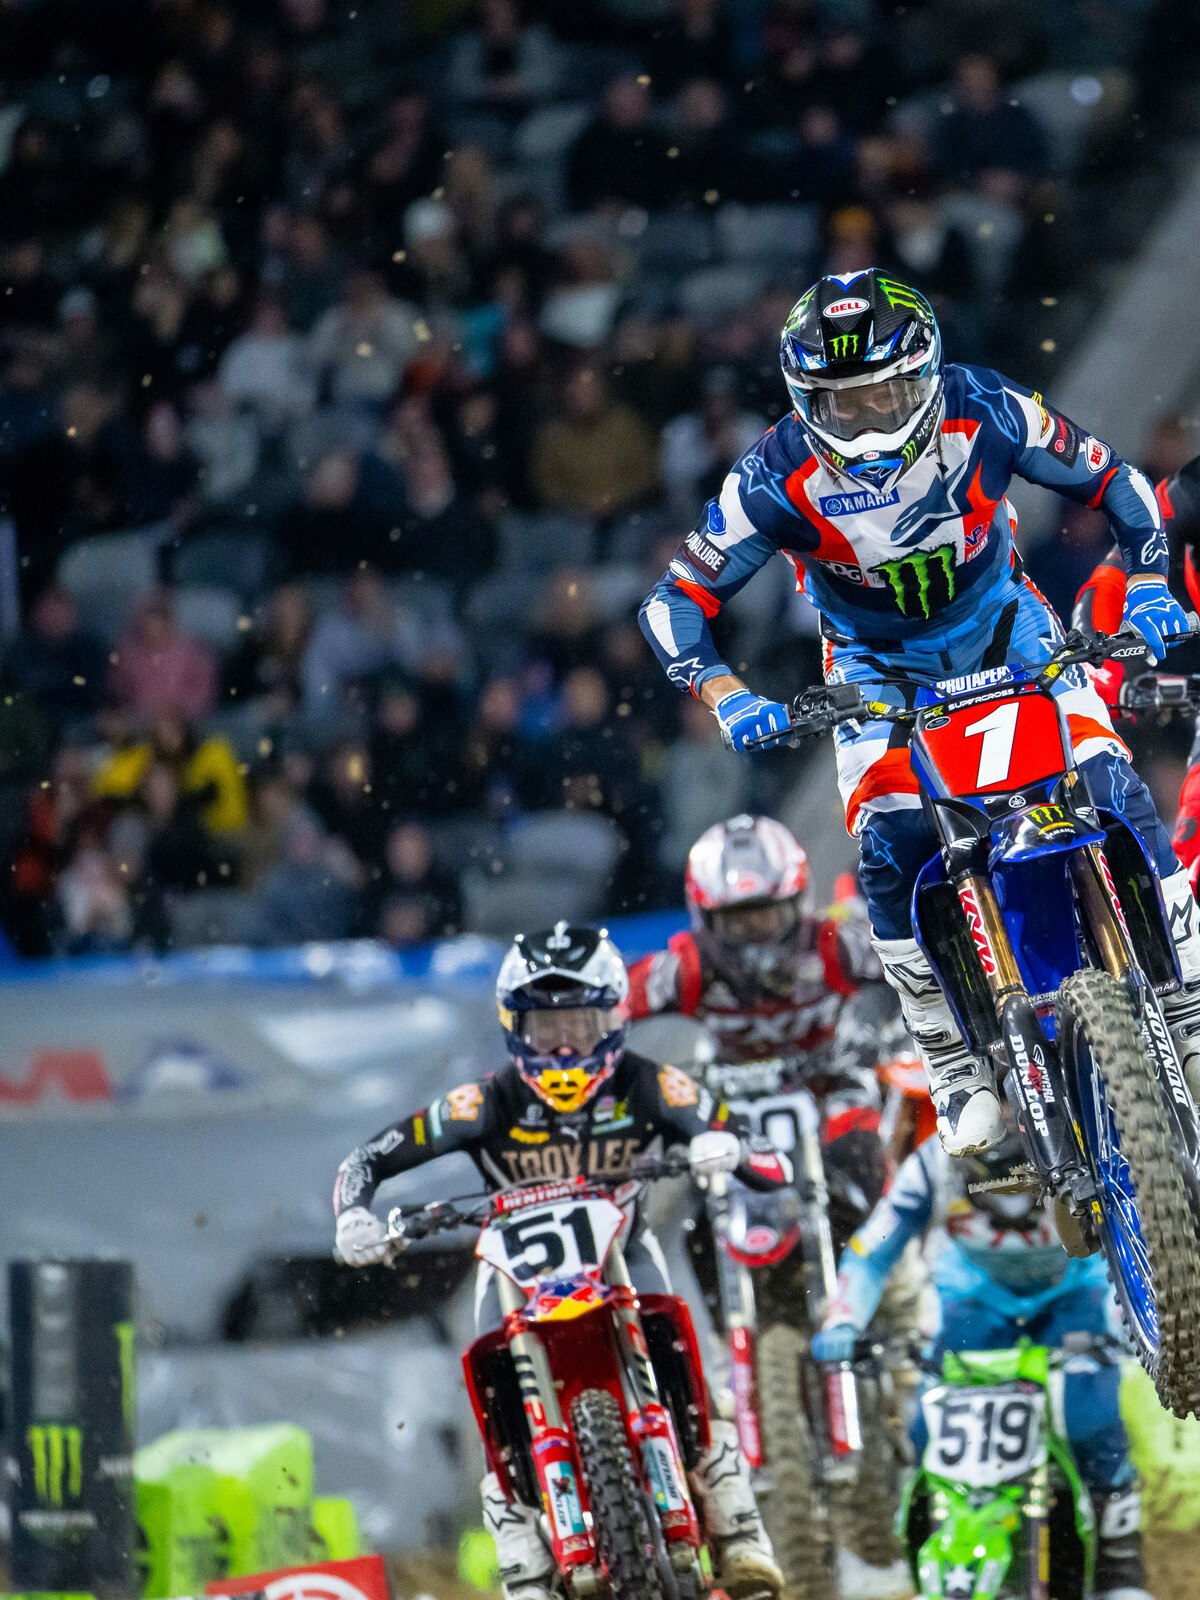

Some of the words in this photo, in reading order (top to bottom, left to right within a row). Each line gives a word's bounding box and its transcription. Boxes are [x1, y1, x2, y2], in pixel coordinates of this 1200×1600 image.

[830, 301, 862, 315] BELL
[842, 493, 895, 512] YAMAHA
[1111, 645, 1147, 658] ARC
[936, 665, 1014, 697] PROTAPER
[963, 701, 1020, 790] 1
[1163, 981, 1176, 991] Air
[1145, 1001, 1190, 1108] DUNLOP
[1009, 1033, 1050, 1138] DUNLOP
[501, 1142, 583, 1181] TROY
[502, 1206, 599, 1281] 51
[938, 1399, 1034, 1466] 519
